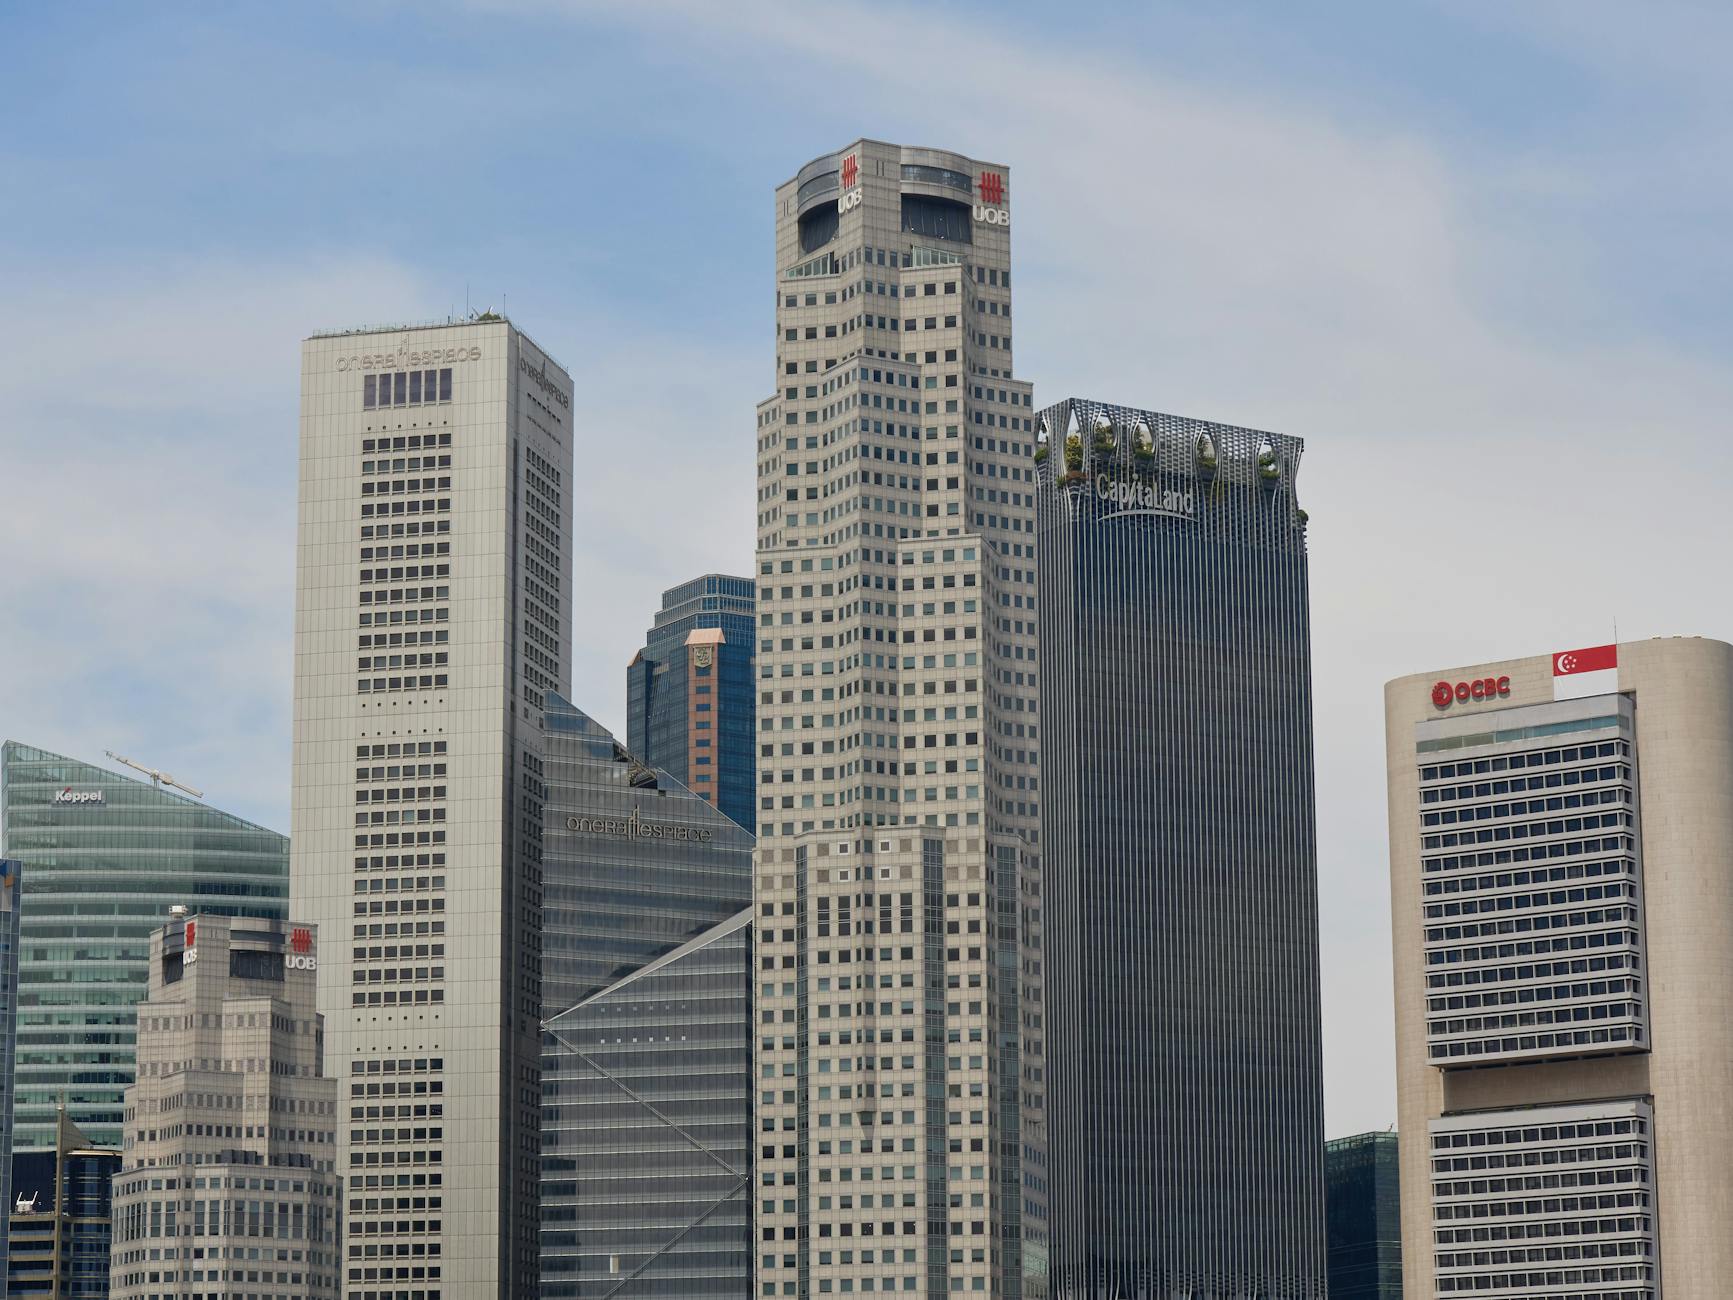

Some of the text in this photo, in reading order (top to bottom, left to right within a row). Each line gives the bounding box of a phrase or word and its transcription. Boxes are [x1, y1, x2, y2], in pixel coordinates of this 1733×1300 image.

[838, 188, 862, 214] UOB
[972, 205, 1009, 226] UOB
[1096, 473, 1195, 513] CapitaLand
[1455, 676, 1511, 699] OCBC
[55, 789, 102, 803] Keppel
[285, 954, 317, 970] UOB
